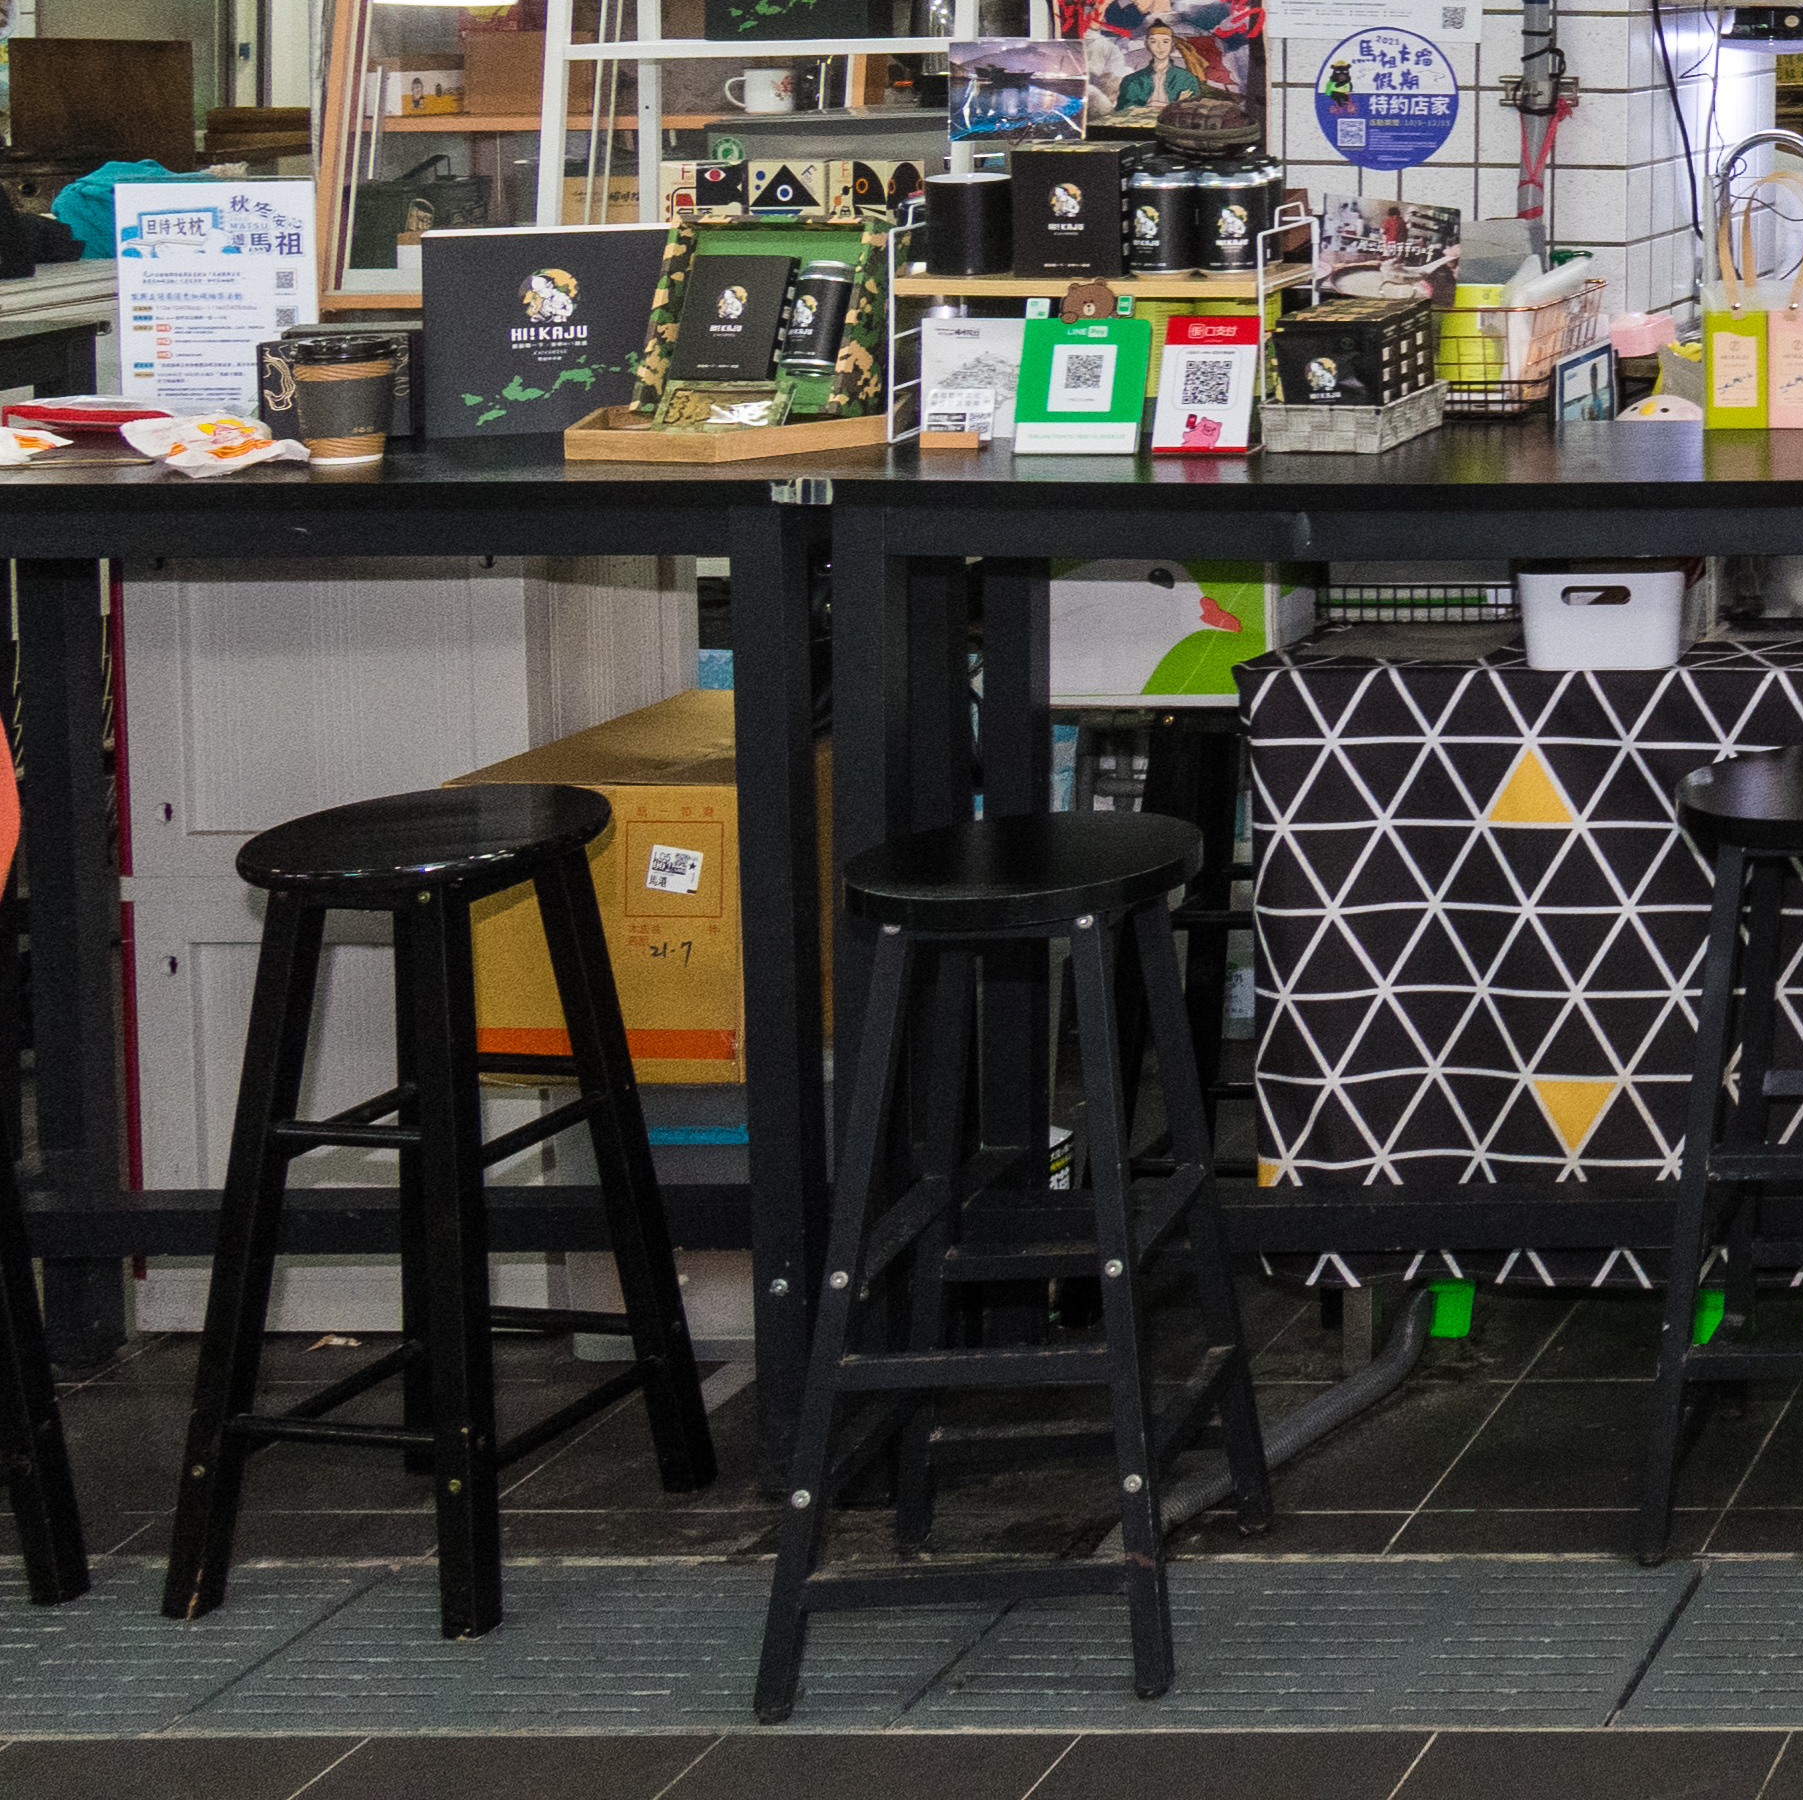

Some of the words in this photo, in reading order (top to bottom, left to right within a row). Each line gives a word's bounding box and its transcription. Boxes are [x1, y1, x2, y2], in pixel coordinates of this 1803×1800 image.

[1372, 68, 1420, 91] 假期
[1369, 94, 1450, 116] 特約店家
[538, 325, 589, 340] KAJU
